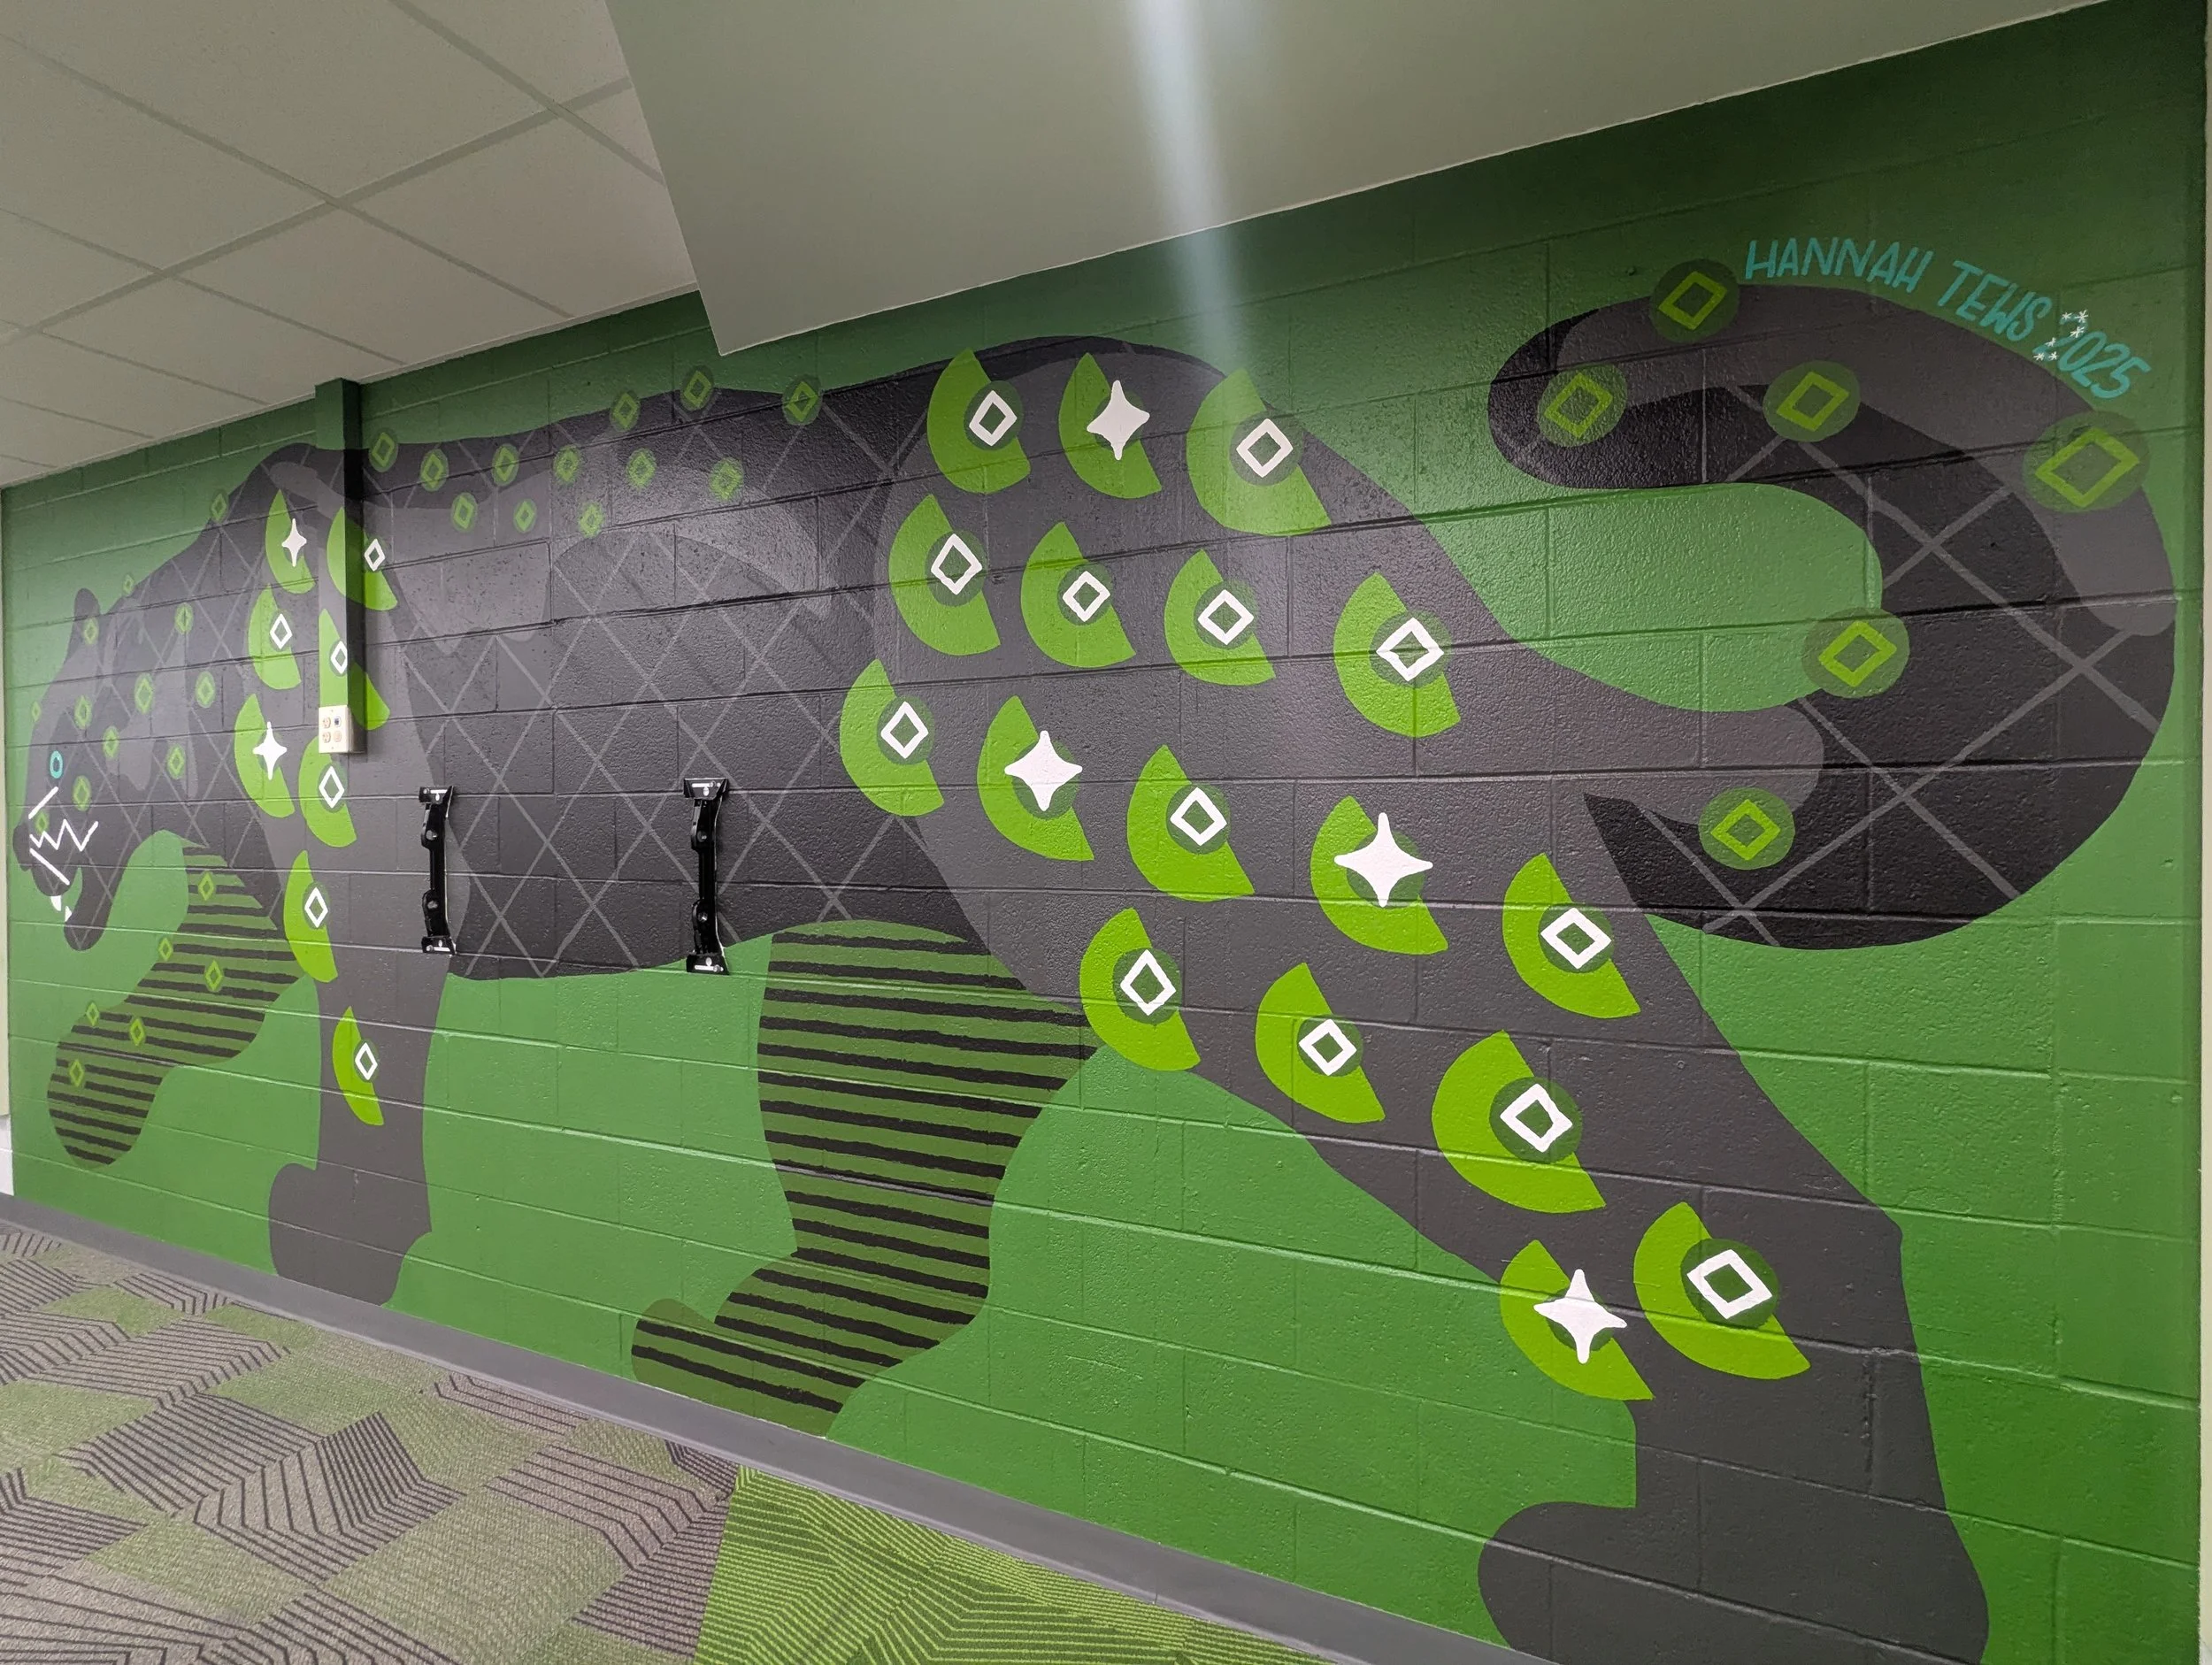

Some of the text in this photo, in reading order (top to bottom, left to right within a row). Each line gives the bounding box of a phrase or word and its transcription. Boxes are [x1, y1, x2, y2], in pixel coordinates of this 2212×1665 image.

[1745, 237, 2152, 399] HANNAH TEWS 2025
